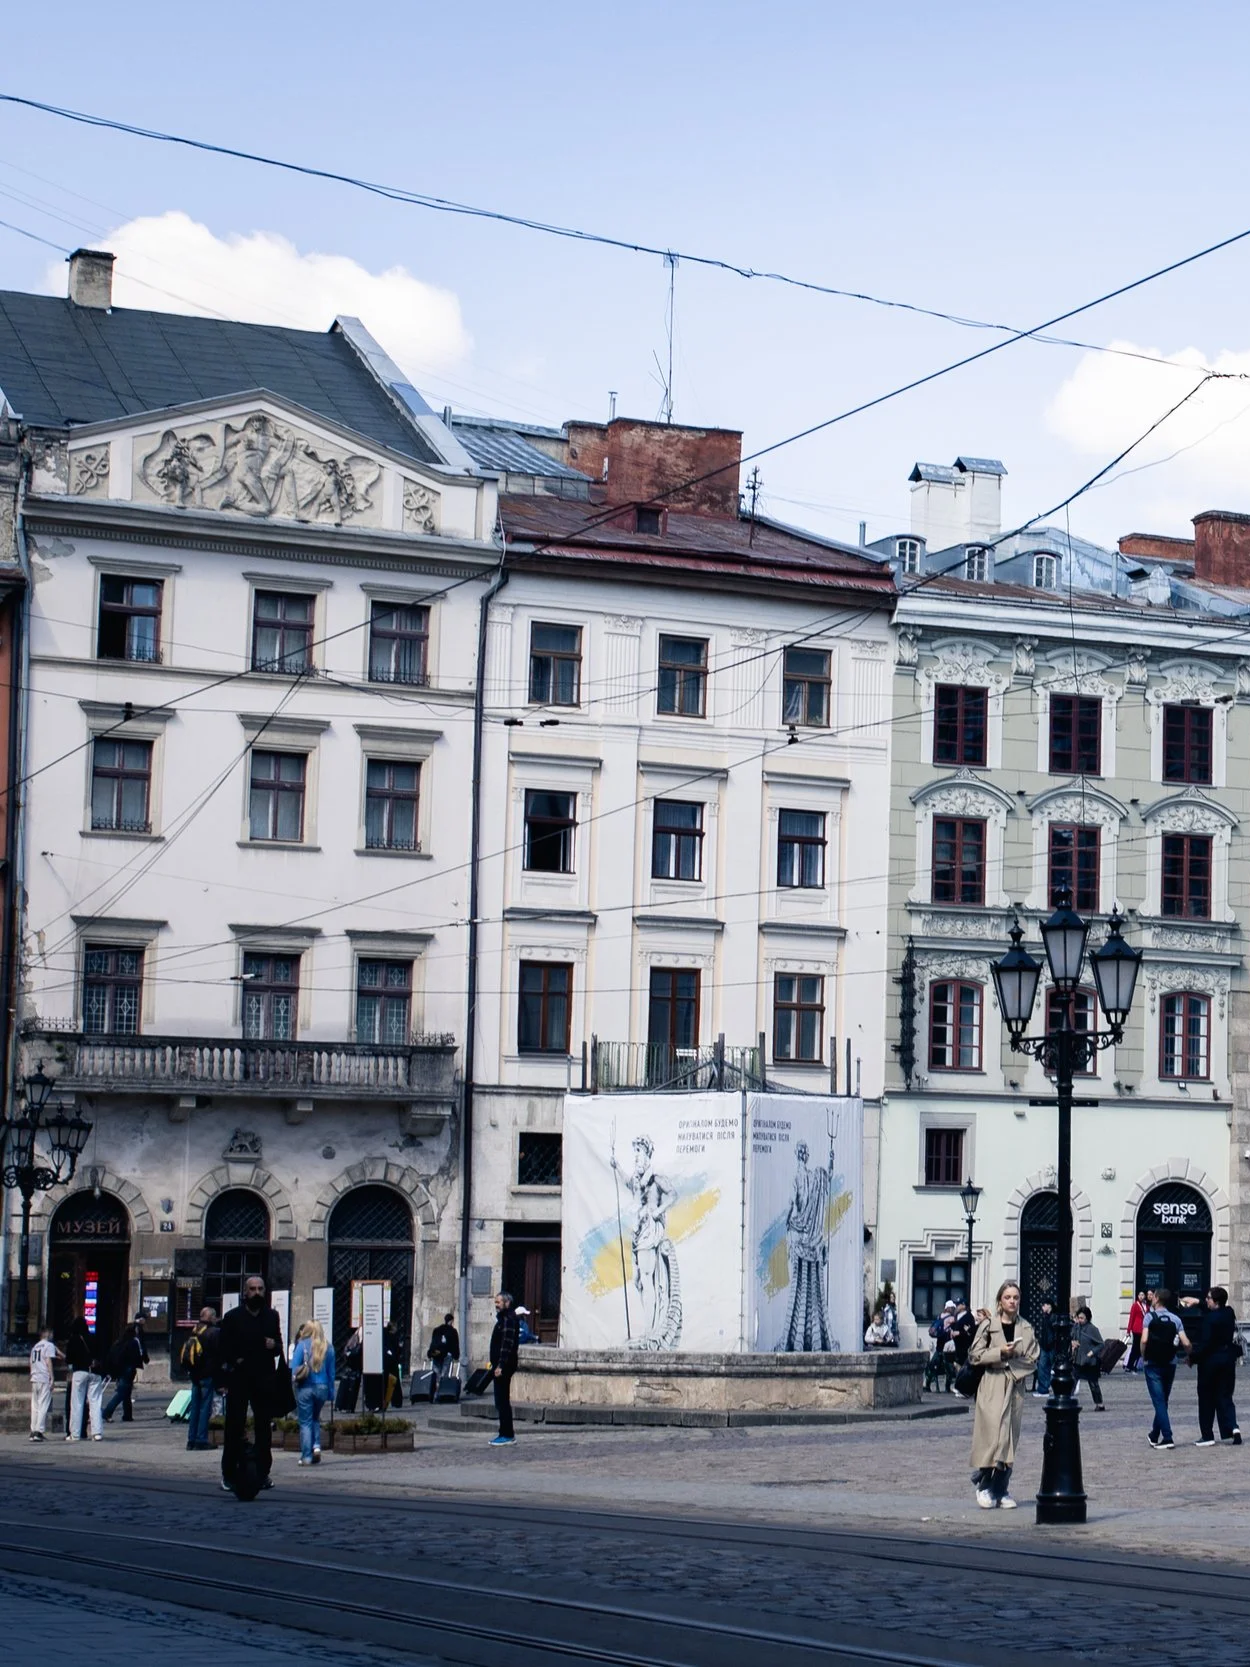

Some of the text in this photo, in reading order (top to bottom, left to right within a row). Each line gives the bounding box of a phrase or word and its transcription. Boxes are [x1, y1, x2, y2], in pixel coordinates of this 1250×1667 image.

[715, 1118, 739, 1128] БУДЕМО
[677, 1131, 735, 1141] МИЛУВАТИСЯ ПІСЛЯ
[676, 1145, 705, 1153] ПЕРЕМОГИ
[1153, 1203, 1197, 1215] sense
[1162, 1215, 1187, 1225] bank
[57, 1218, 121, 1234] МУЗЕЙ
[163, 1221, 172, 1231] 24
